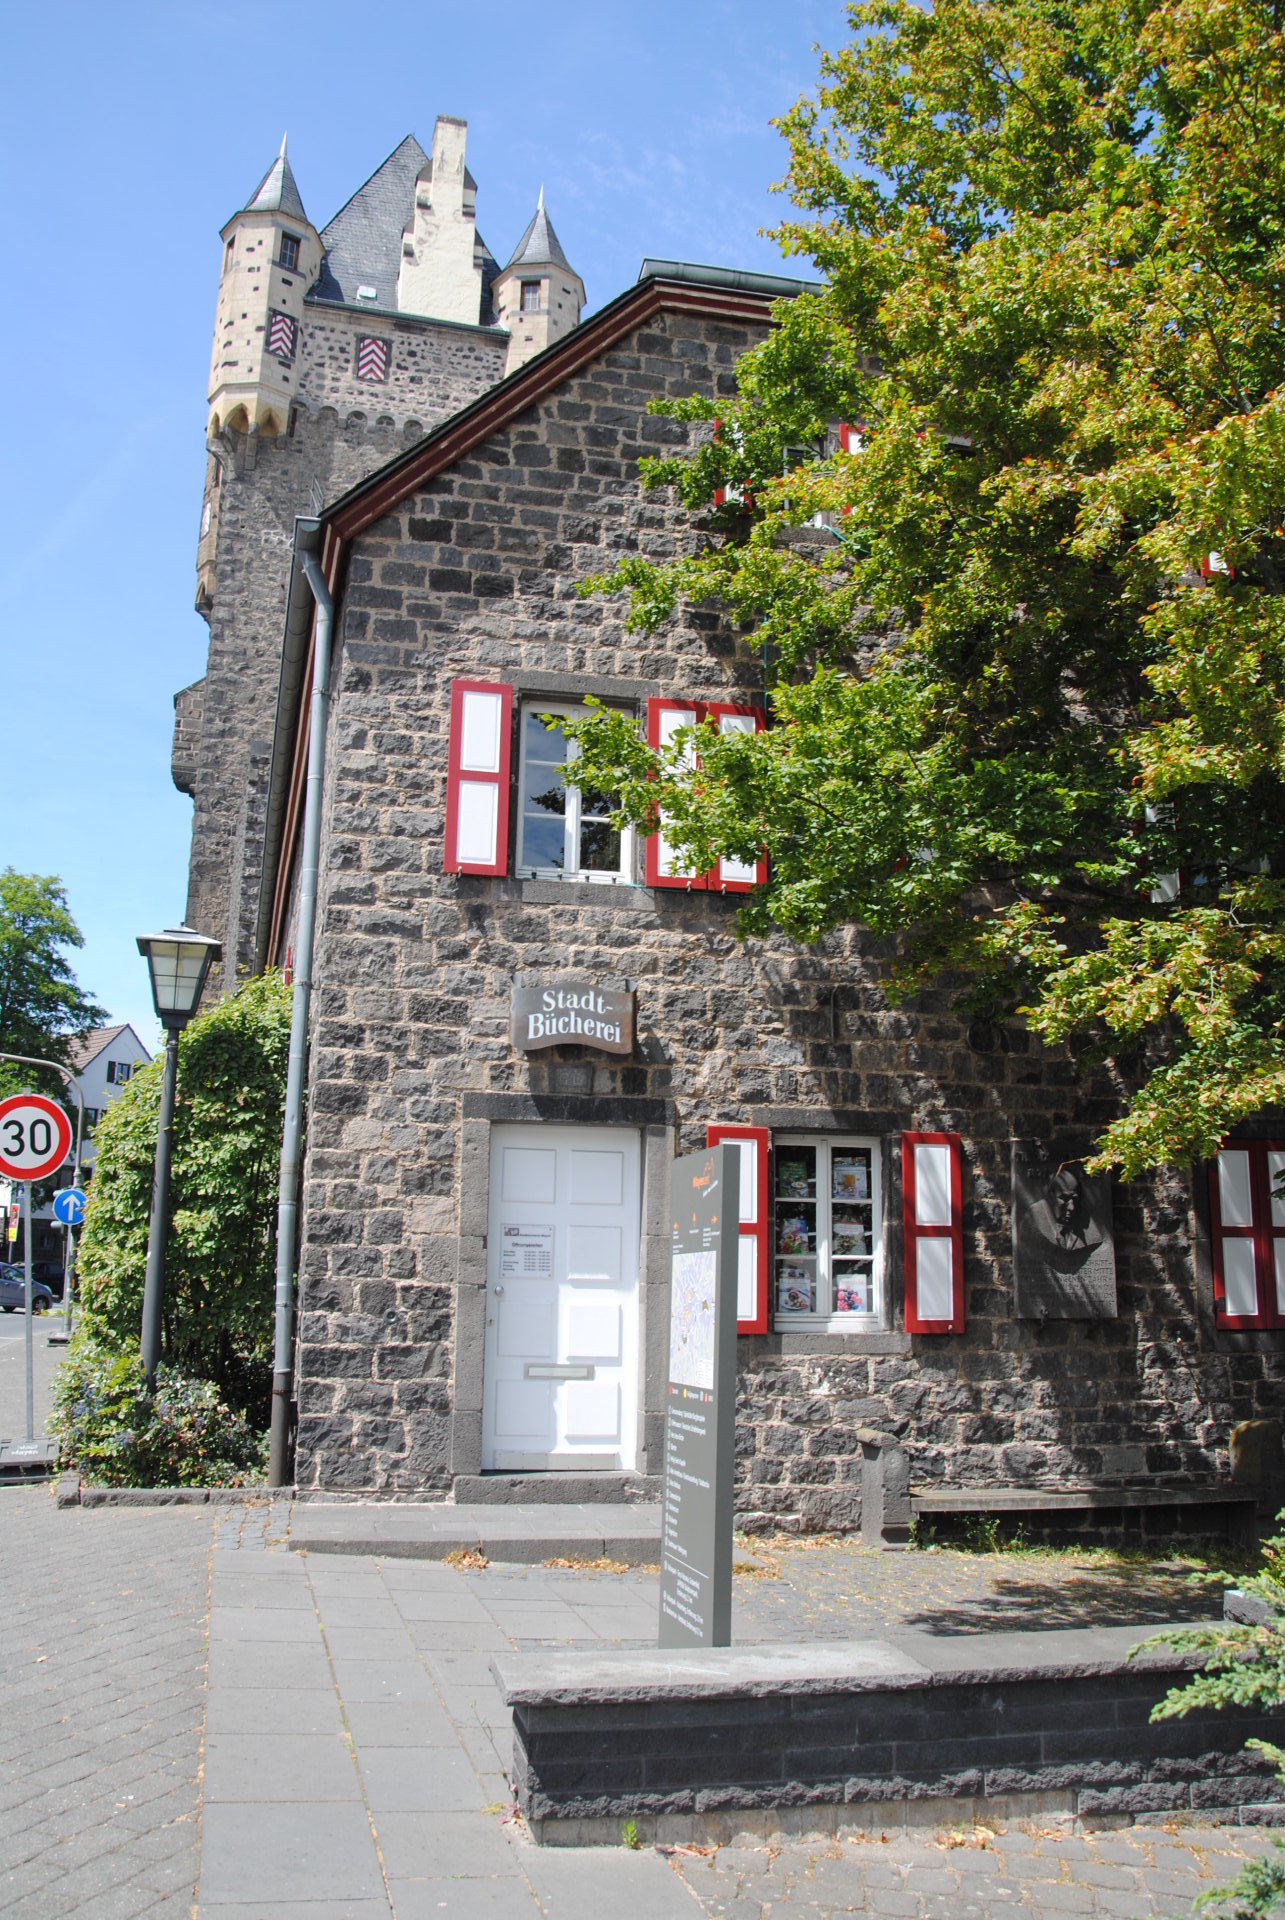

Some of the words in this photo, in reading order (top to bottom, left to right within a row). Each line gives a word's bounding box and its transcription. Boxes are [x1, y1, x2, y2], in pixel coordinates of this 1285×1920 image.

[542, 989, 614, 1015] Stadt-
[527, 1011, 622, 1044] Bücherei
[2, 1118, 52, 1157] 30
